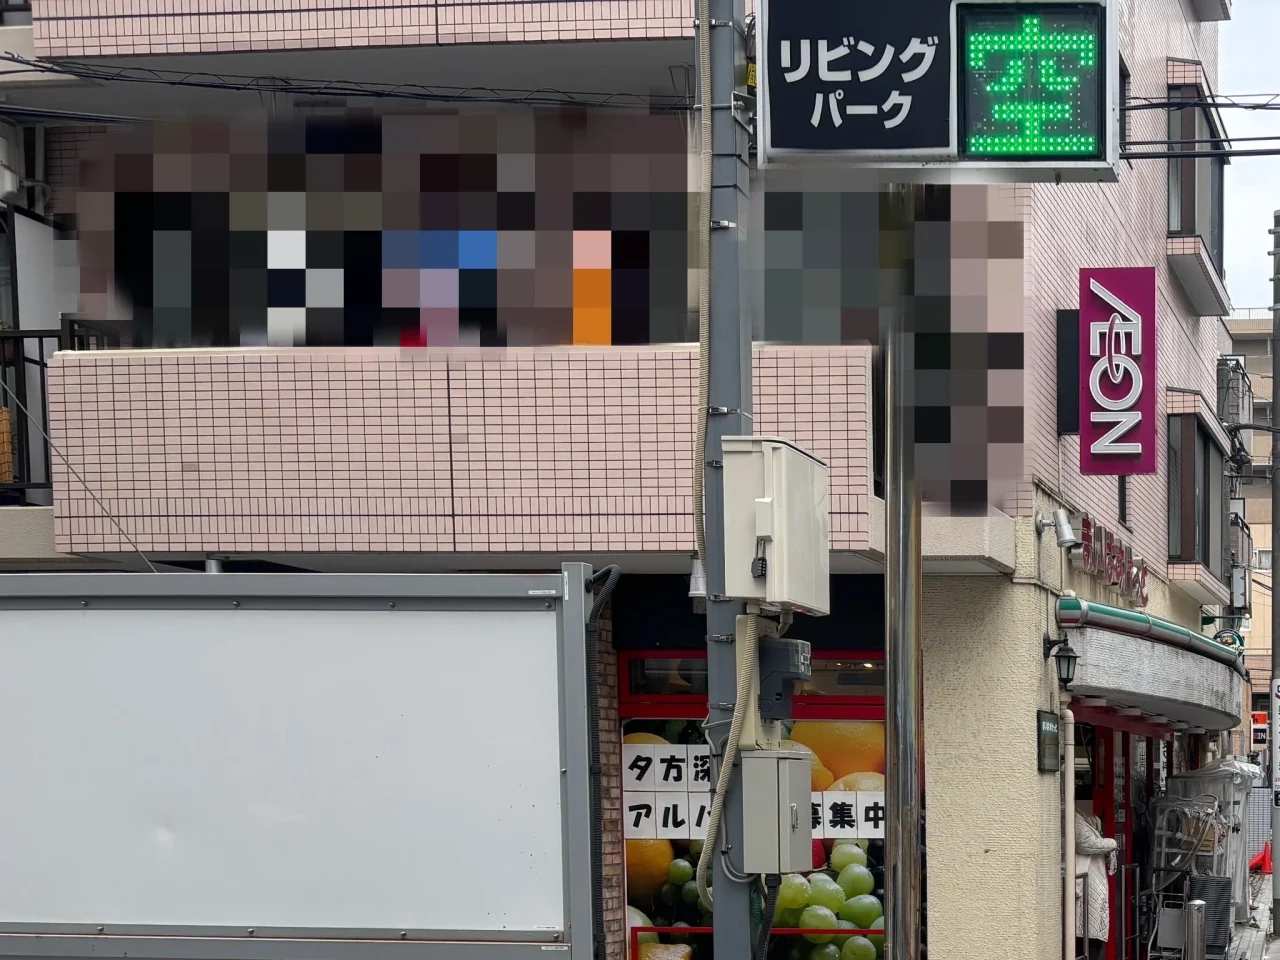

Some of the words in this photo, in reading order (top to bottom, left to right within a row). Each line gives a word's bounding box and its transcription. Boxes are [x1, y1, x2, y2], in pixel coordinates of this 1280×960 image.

[780, 36, 939, 84] リビング
[969, 17, 1096, 155] 空
[810, 89, 913, 129] パーク
[1089, 278, 1143, 455] AEON
